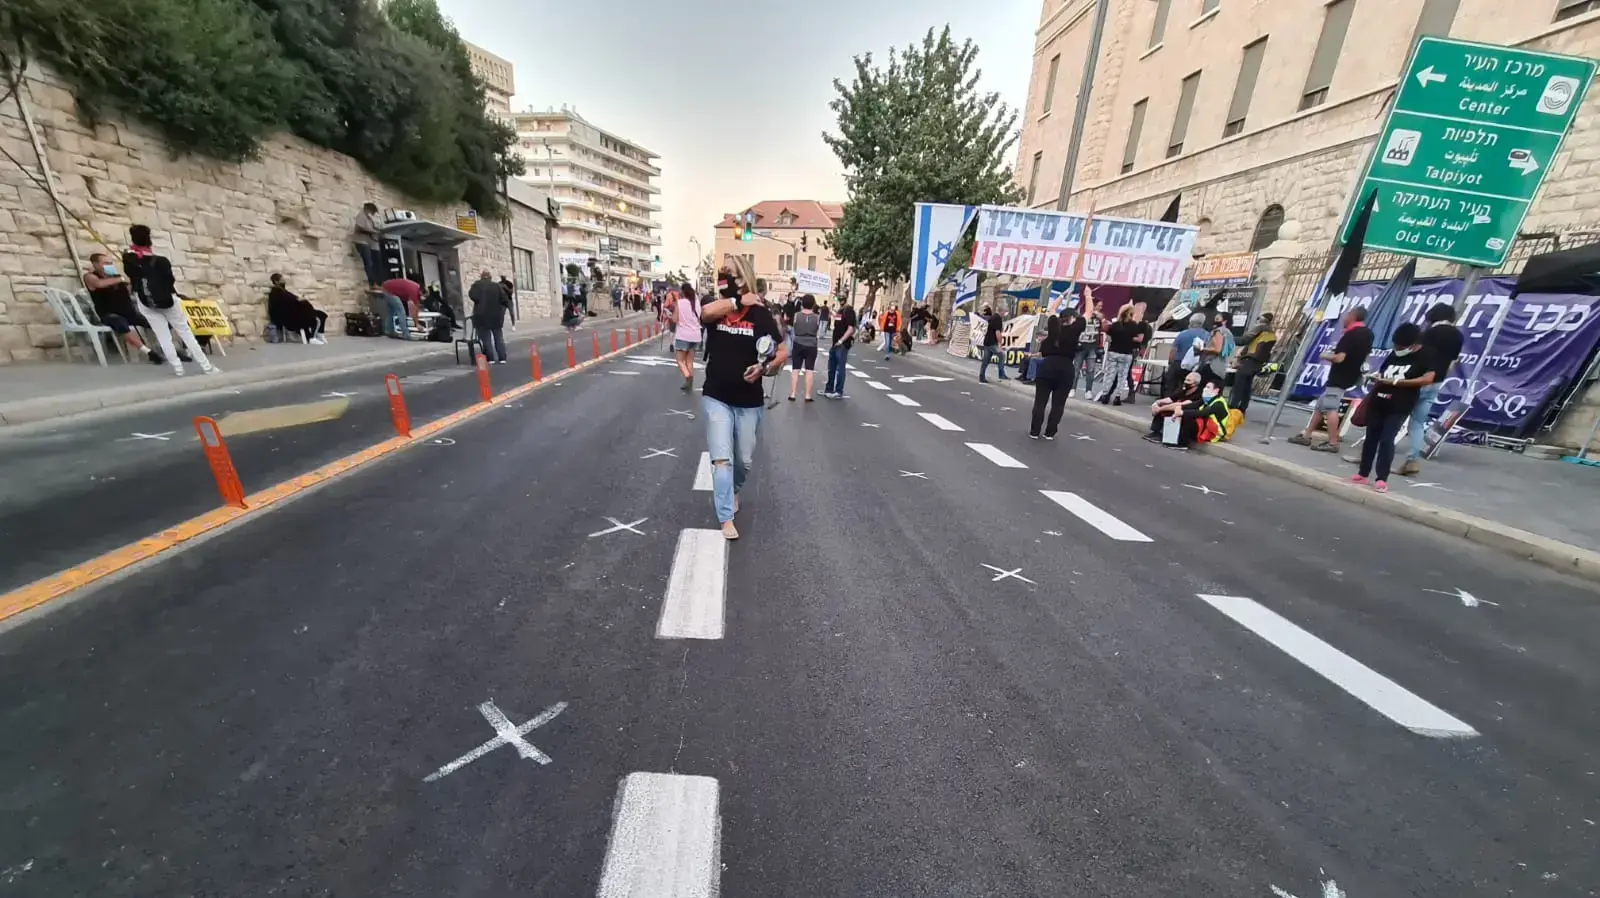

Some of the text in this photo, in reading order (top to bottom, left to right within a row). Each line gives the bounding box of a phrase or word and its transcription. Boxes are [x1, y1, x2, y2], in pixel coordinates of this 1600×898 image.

[1464, 53, 1545, 78] מרכז העיר
[1458, 76, 1528, 99] مركز المدينة
[1459, 97, 1511, 116] Center
[1442, 127, 1499, 146] תלפיות
[1424, 165, 1484, 185] Talpiyot
[1392, 191, 1491, 217] העיר העתיקה
[1398, 212, 1469, 233] البلدة القديمة
[1395, 229, 1456, 251] Old City
[716, 323, 754, 337] MINISTER
[1487, 392, 1527, 419] SQ.
